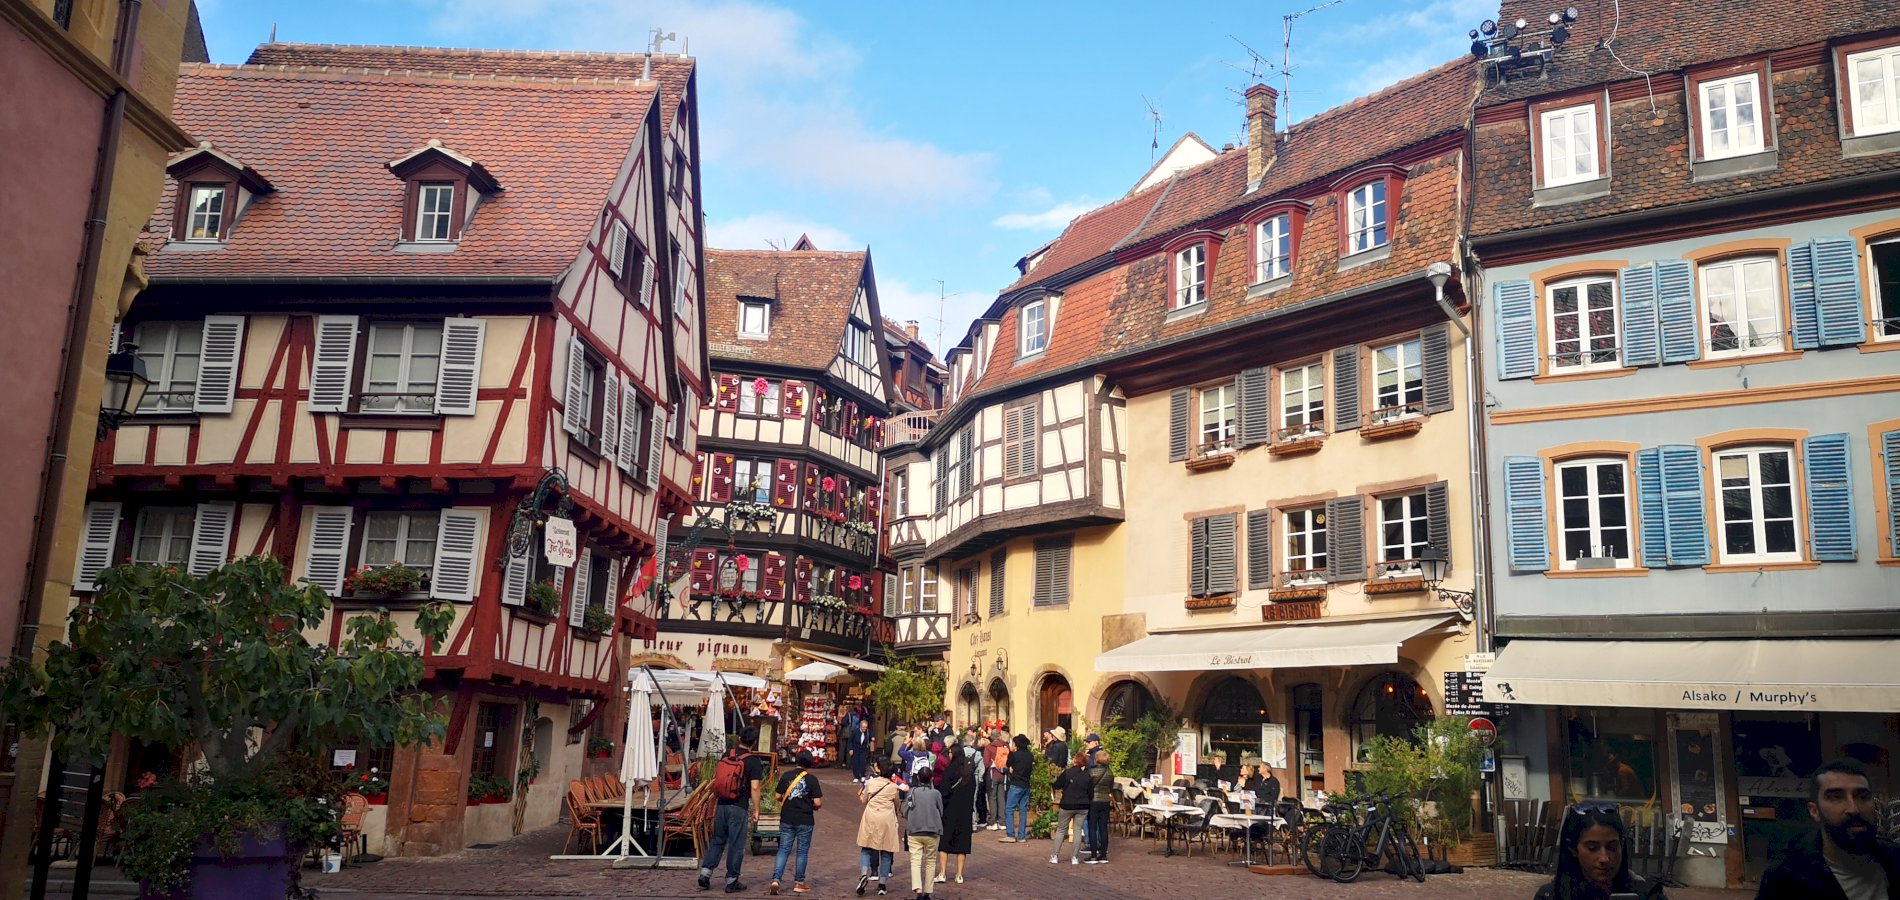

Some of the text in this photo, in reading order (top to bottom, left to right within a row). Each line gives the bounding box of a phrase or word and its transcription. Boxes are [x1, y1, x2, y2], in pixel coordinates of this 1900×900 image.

[1263, 603, 1318, 620] LE BISTROT
[697, 637, 748, 656] pignon
[1210, 655, 1252, 665] Le Bistrot
[1682, 690, 1817, 704] Alsako / Murphy's
